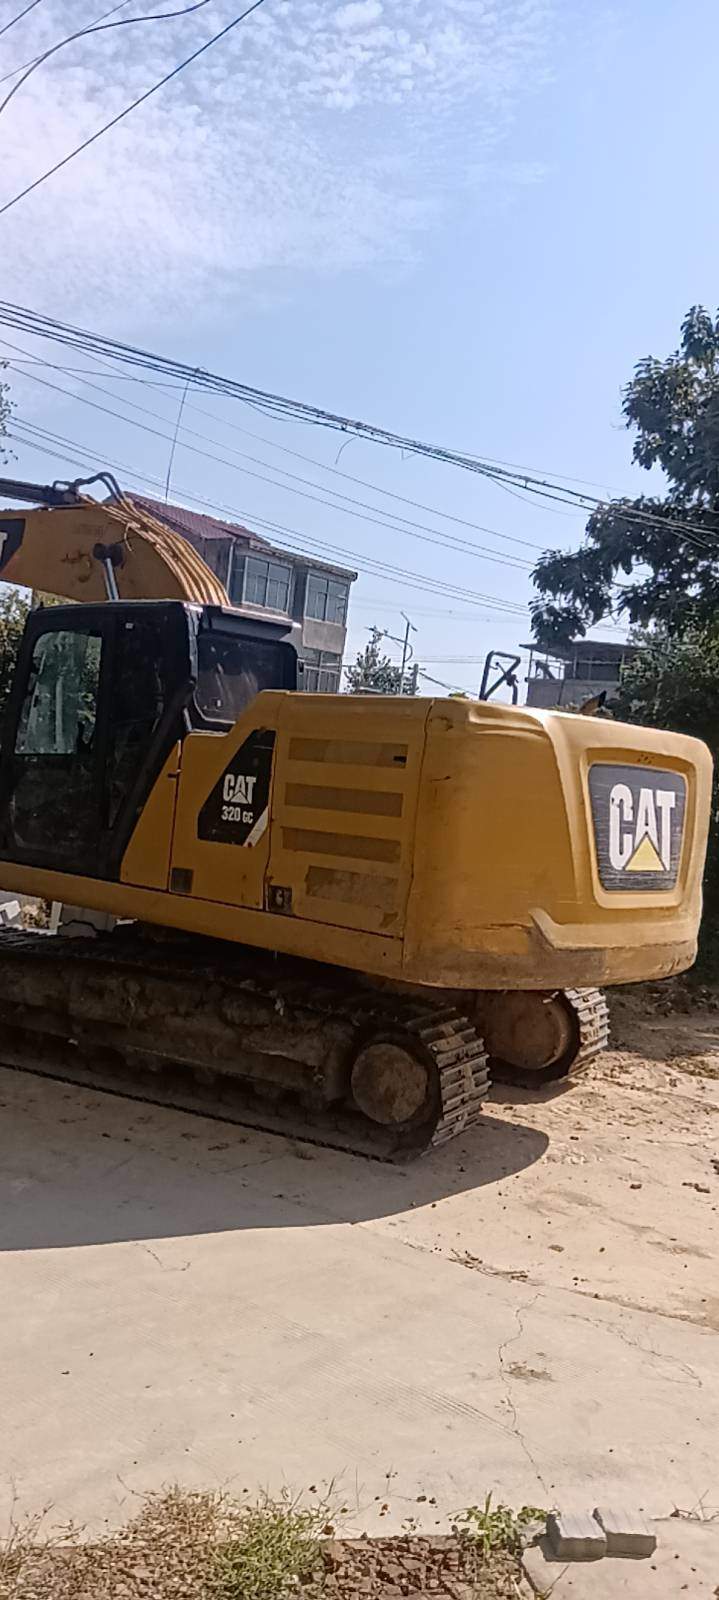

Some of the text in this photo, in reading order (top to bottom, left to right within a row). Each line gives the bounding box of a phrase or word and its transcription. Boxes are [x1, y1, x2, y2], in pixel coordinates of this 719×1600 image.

[223, 774, 257, 804] CAT
[221, 805, 254, 824] 320 GC
[609, 783, 675, 871] CAT
